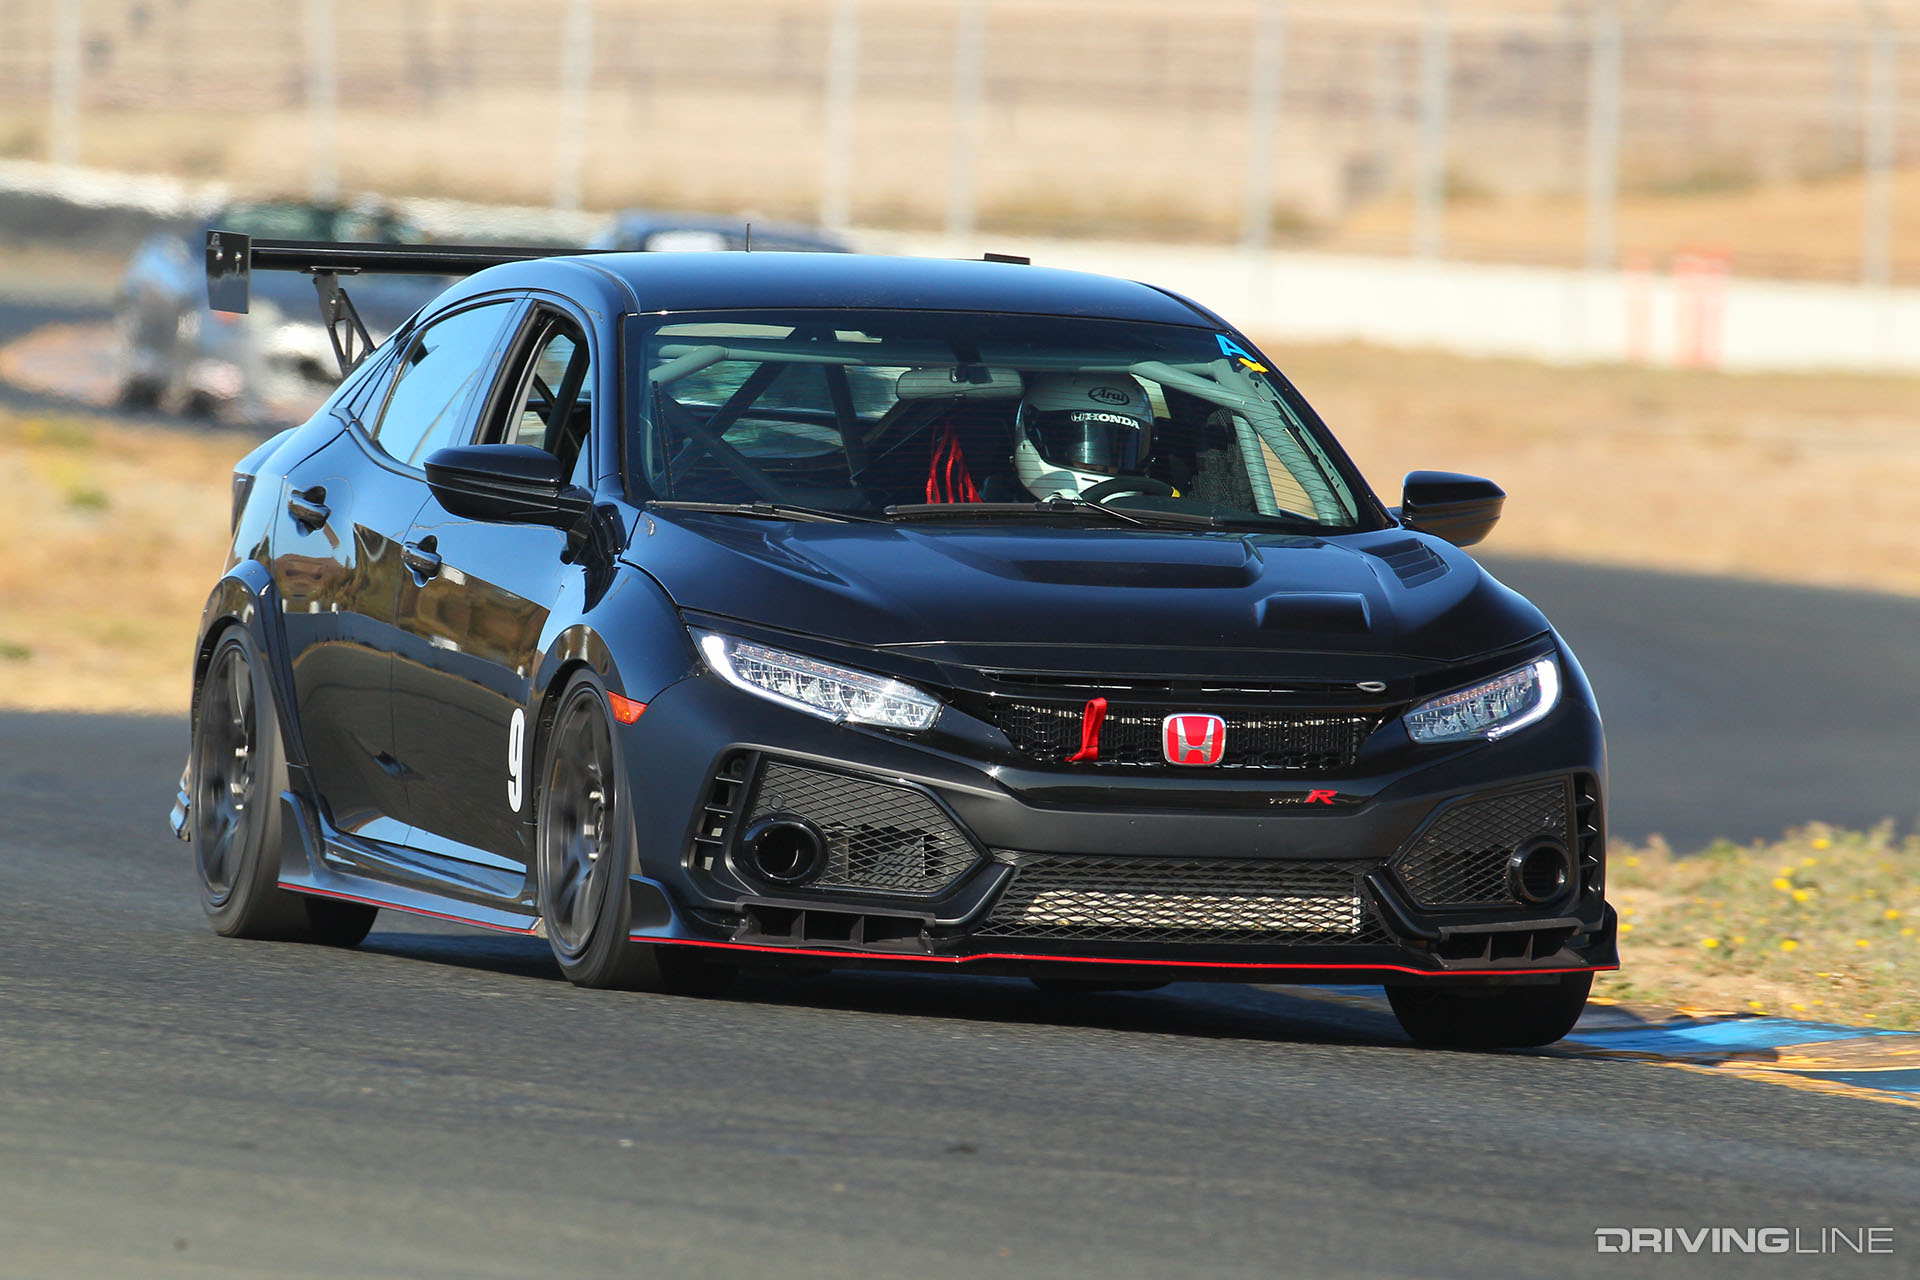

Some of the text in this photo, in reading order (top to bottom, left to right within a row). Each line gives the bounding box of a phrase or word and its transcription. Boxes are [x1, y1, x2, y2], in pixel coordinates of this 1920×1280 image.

[1092, 388, 1126, 402] Arai
[1084, 412, 1141, 430] HONDA
[508, 707, 525, 813] 9
[1305, 789, 1338, 805] R
